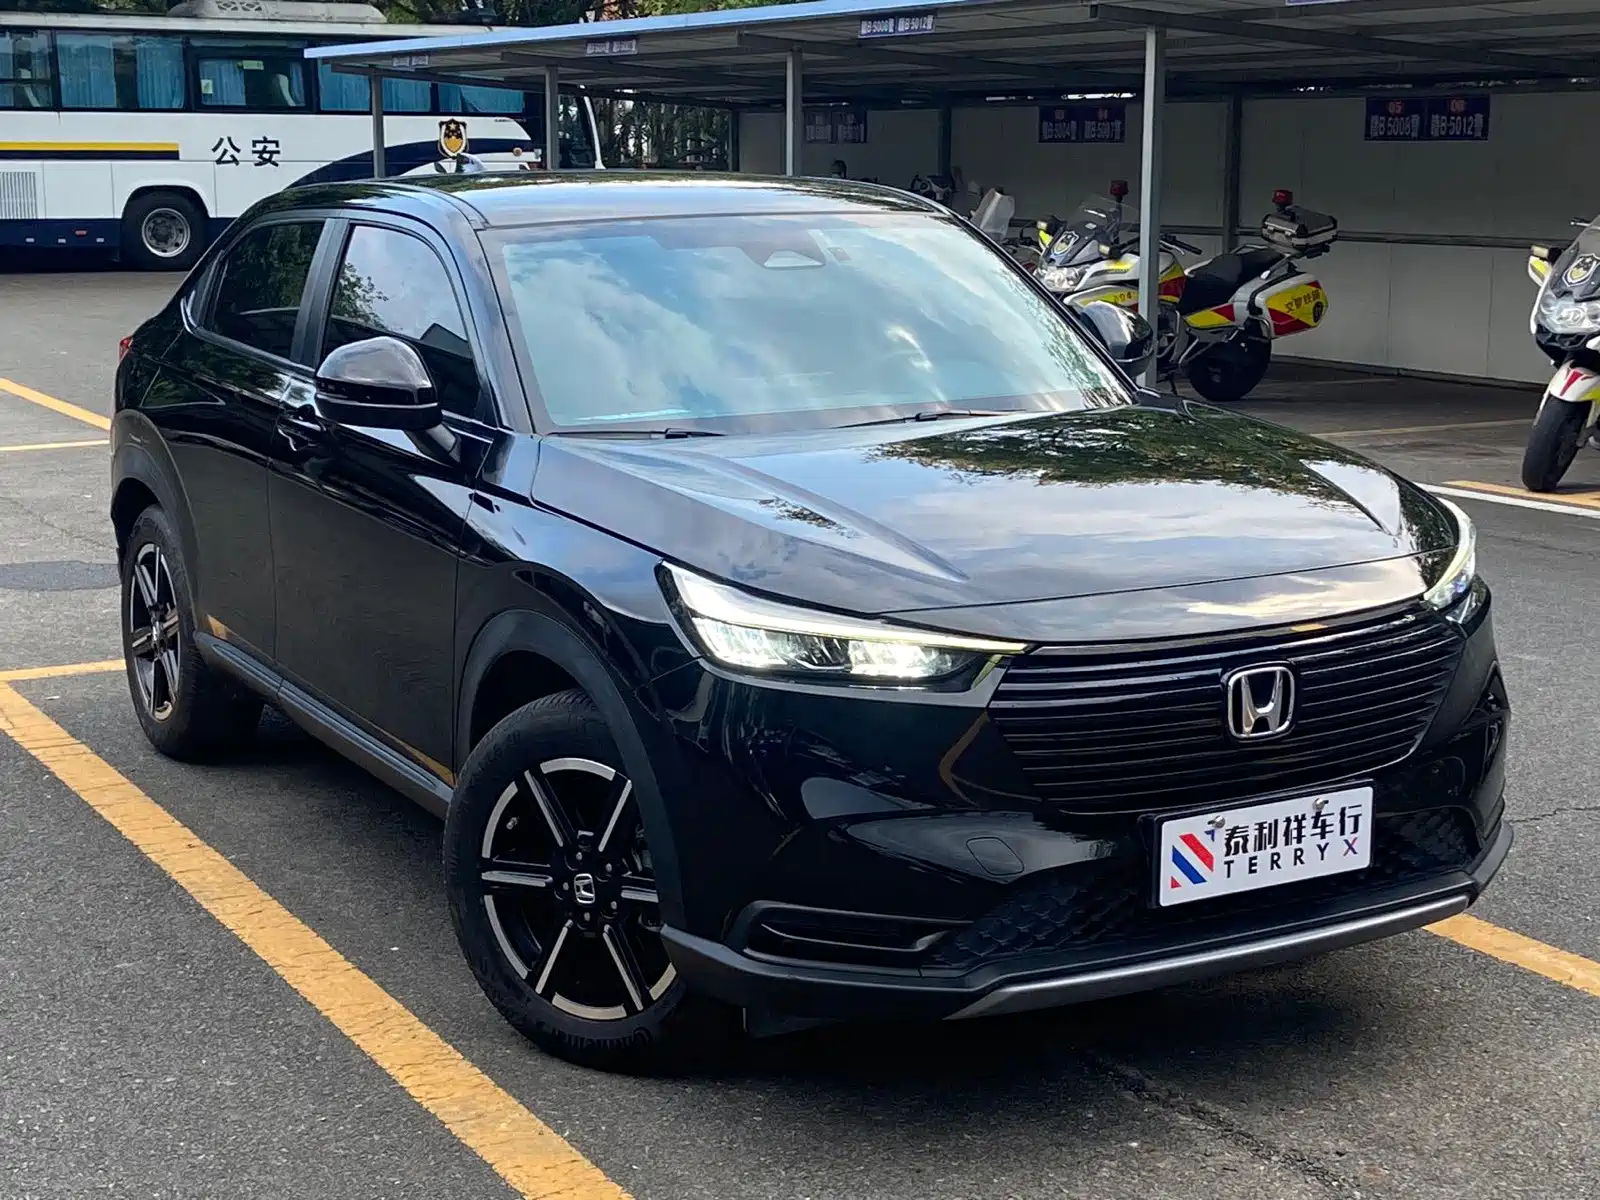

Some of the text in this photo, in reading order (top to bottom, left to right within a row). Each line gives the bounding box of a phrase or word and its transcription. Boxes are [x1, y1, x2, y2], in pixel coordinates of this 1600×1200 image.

[211, 136, 281, 167] 公安
[1224, 804, 1363, 857] 泰利祥车行
